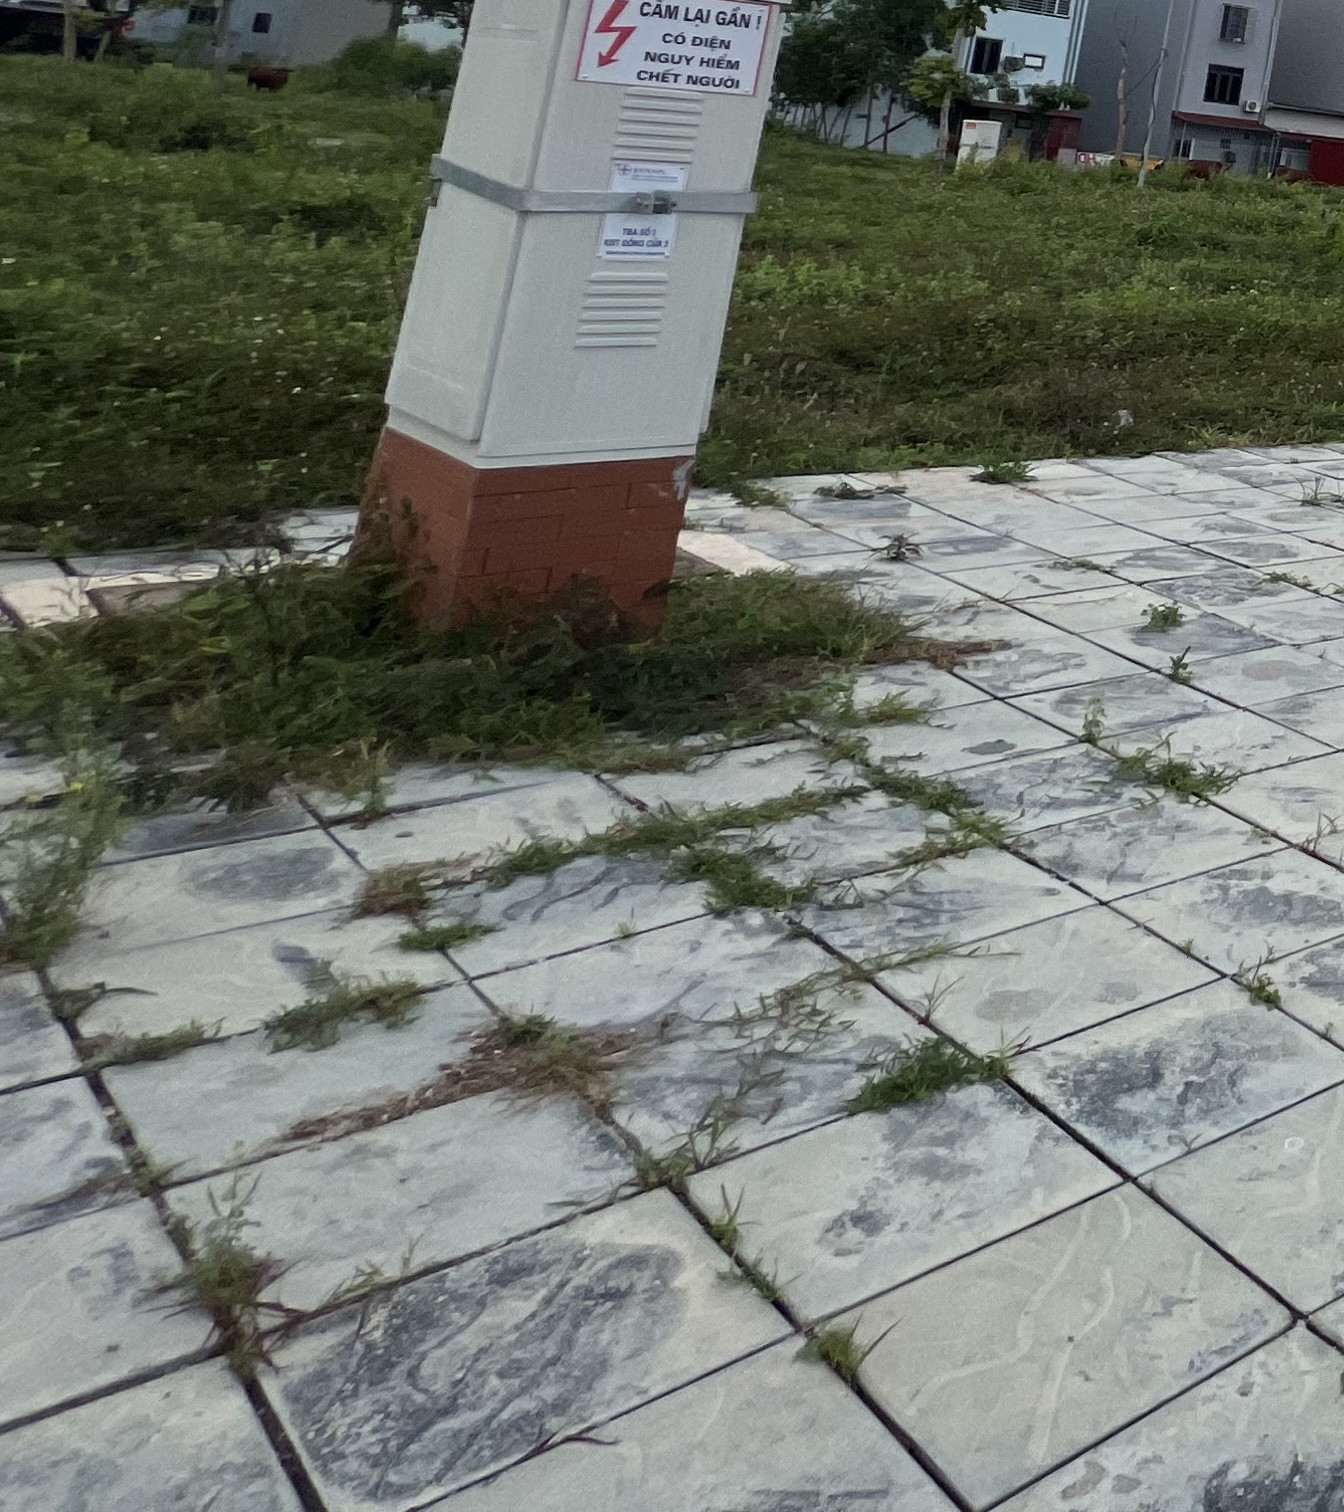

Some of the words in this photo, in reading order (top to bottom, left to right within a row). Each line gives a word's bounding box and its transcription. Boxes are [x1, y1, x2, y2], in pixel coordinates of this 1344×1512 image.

[683, 7, 711, 28] LẠI
[662, 31, 686, 45] CÓ
[644, 51, 695, 66] NGUY
[699, 53, 740, 70] HIỂM
[636, 69, 682, 85] CHẾT
